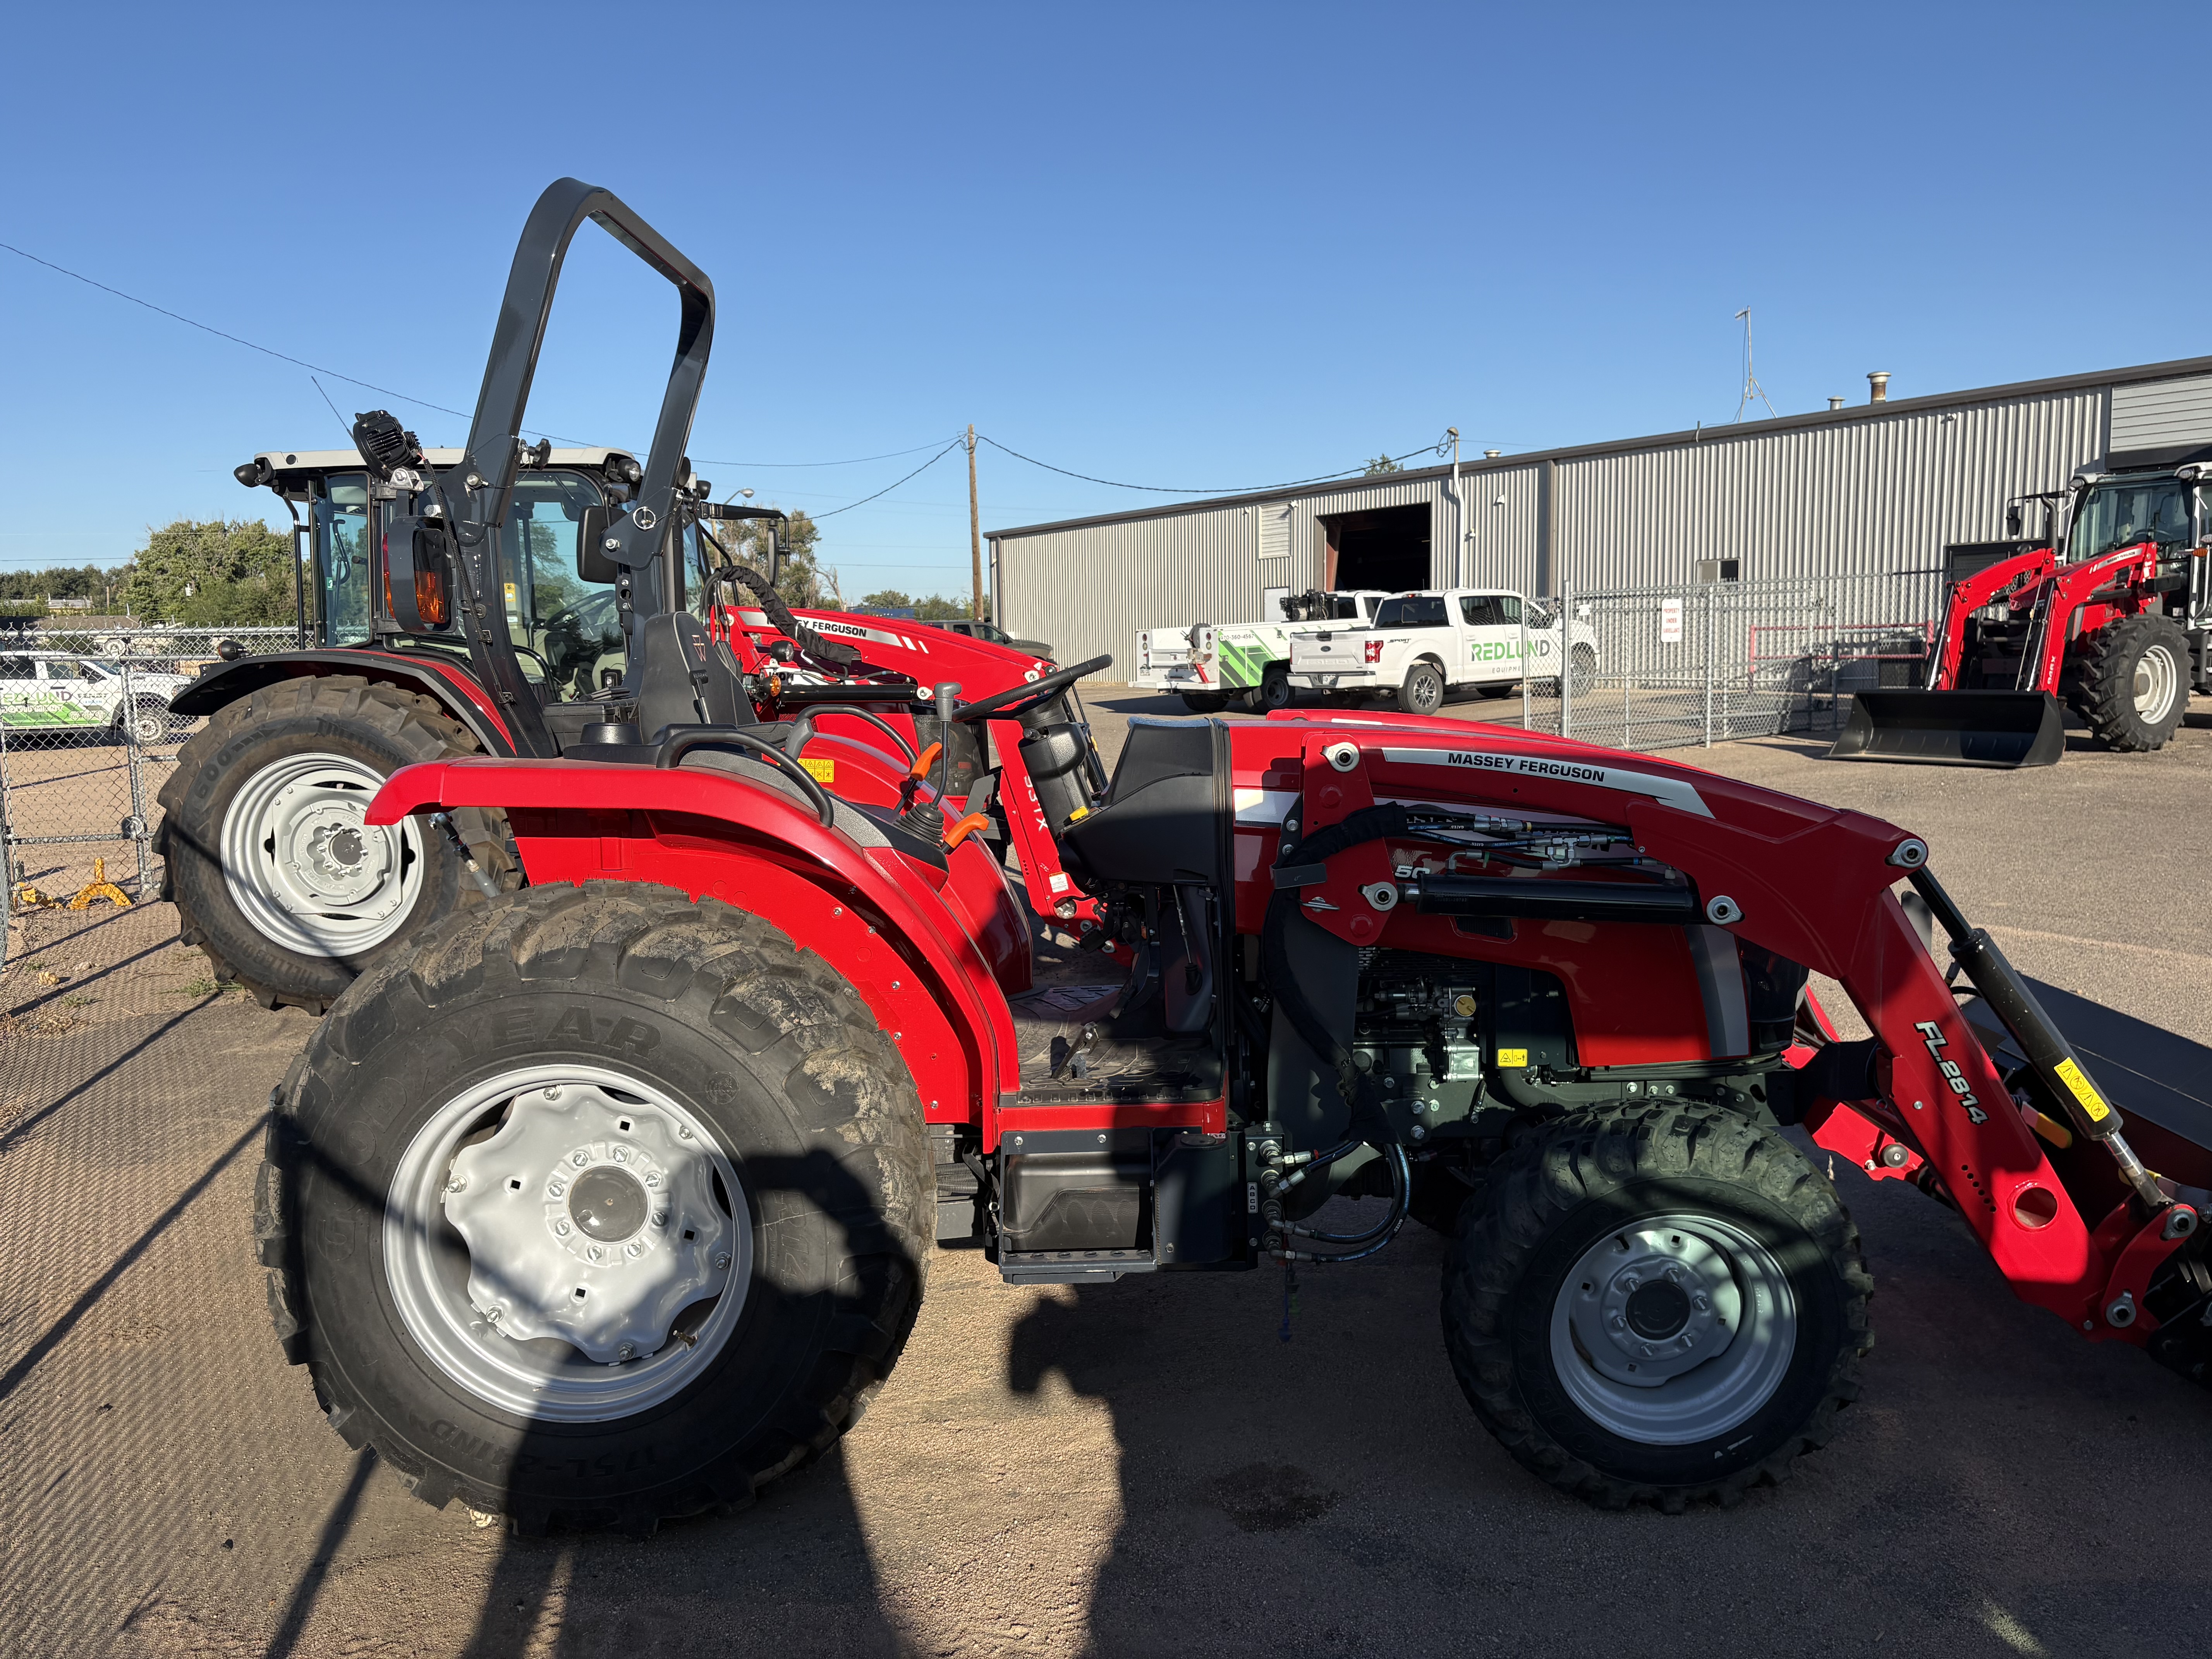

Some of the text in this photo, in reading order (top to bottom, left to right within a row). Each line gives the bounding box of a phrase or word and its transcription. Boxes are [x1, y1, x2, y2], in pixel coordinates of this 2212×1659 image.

[812, 621, 867, 637] FERGUSON
[1471, 639, 1550, 661] REDLUND
[1492, 666, 1521, 674] EQUIPME
[1, 691, 72, 706] EDLUND
[1448, 753, 1605, 782] MASSEY FERGUSON
